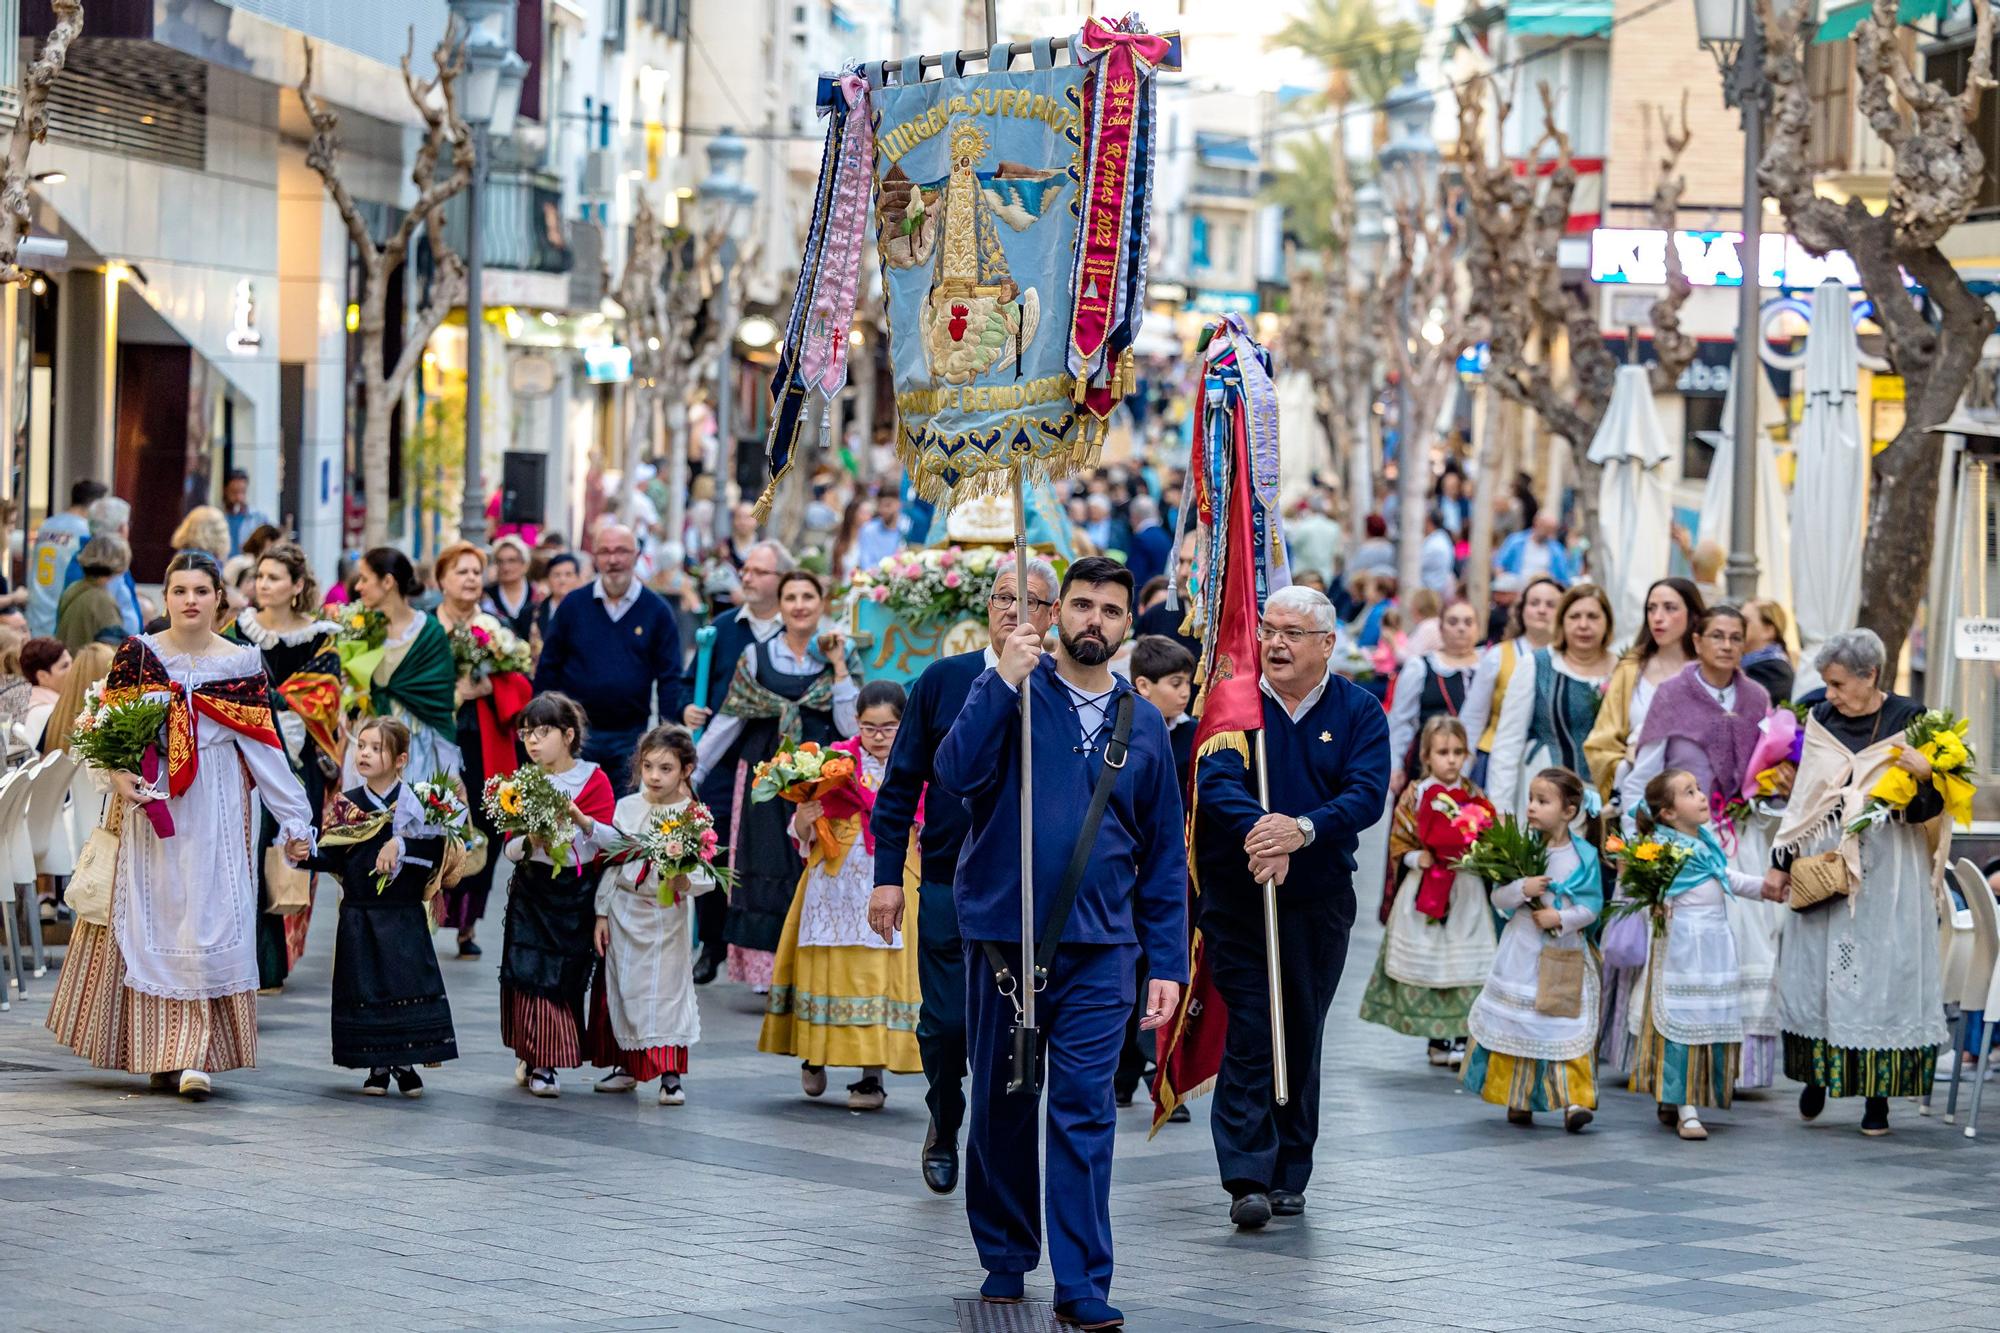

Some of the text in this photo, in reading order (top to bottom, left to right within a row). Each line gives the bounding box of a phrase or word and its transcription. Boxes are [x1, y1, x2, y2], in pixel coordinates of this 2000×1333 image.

[880, 101, 949, 163] VIRGEN
[1096, 143, 1121, 247] Reines 2022
[37, 547, 56, 586] 6
[1188, 998, 1203, 1016] B
